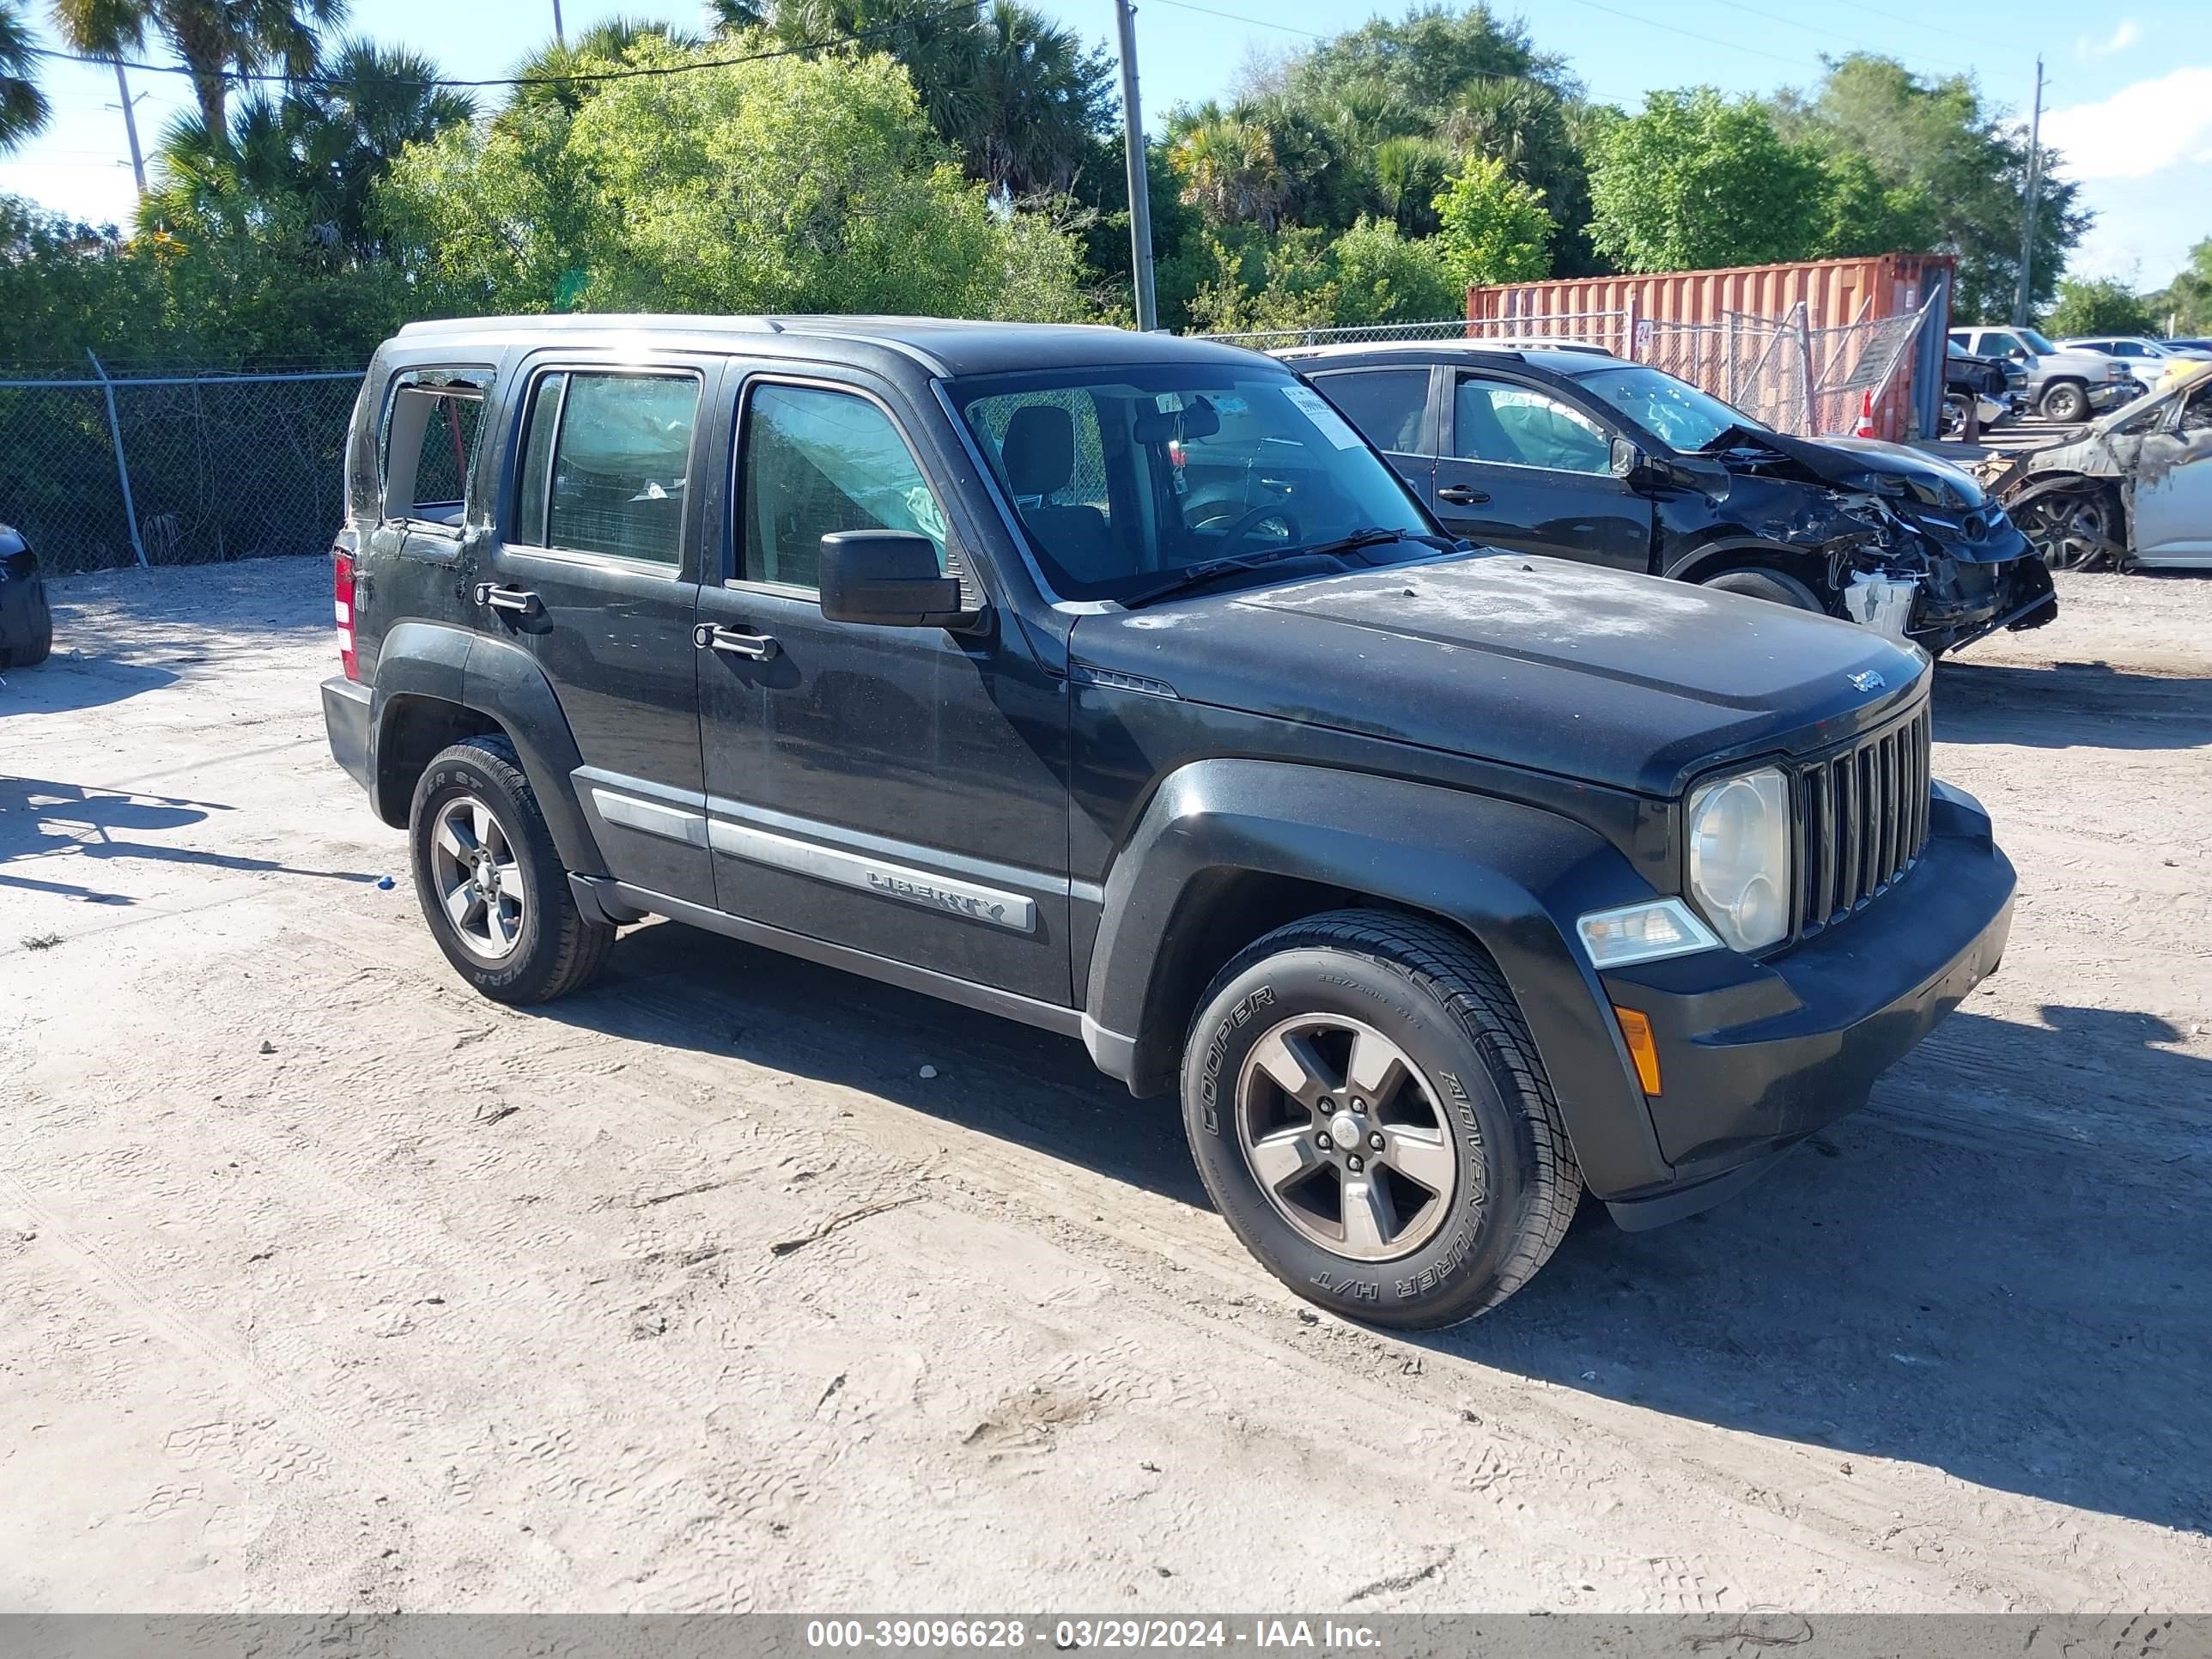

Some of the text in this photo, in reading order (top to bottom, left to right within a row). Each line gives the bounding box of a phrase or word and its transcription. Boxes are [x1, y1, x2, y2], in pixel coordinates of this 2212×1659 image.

[1638, 325, 1650, 342] 24
[866, 870, 1006, 923] LIBERTY
[1200, 985, 1275, 1135] COOPER
[1310, 1070, 1491, 1300] ADVENTURER H/T
